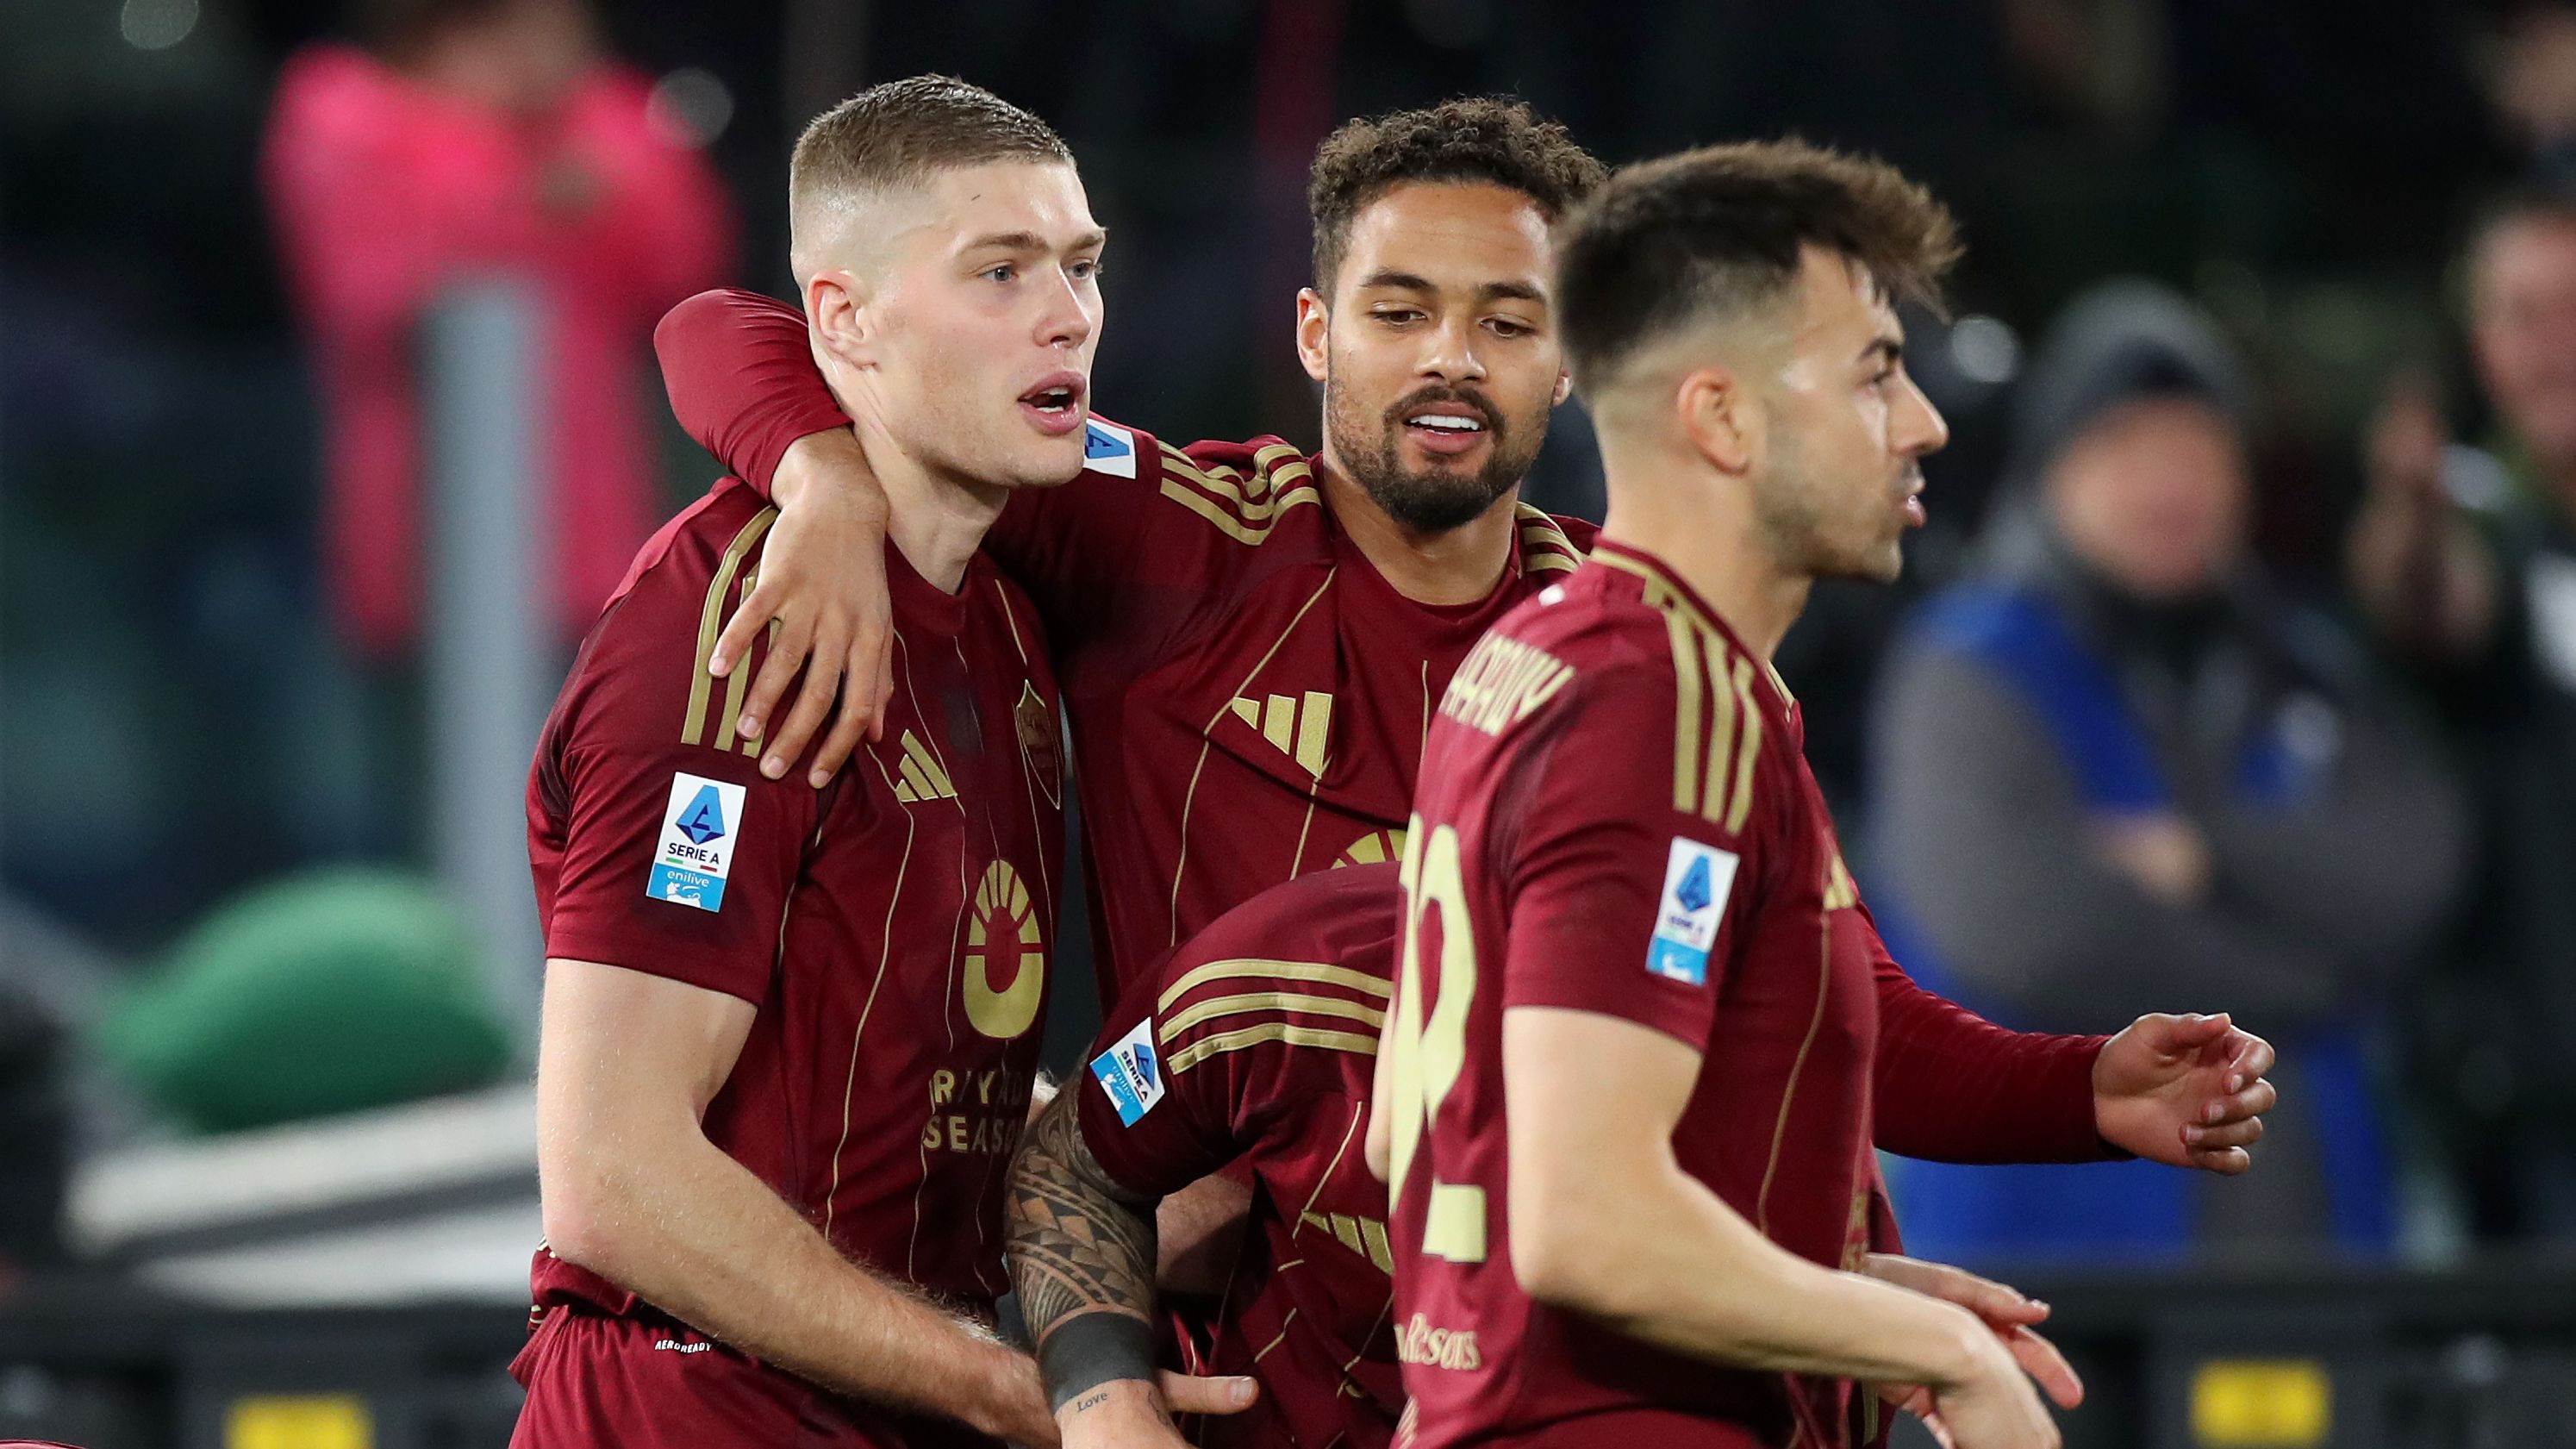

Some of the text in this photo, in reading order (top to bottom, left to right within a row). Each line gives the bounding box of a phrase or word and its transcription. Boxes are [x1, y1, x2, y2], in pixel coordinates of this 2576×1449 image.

[667, 842, 720, 865] SERIE A
[666, 870, 710, 888] enilive
[1121, 1050, 1149, 1101] SERIE A
[655, 1340, 713, 1354] AEROREADY
[1076, 1392, 1107, 1413] Love
